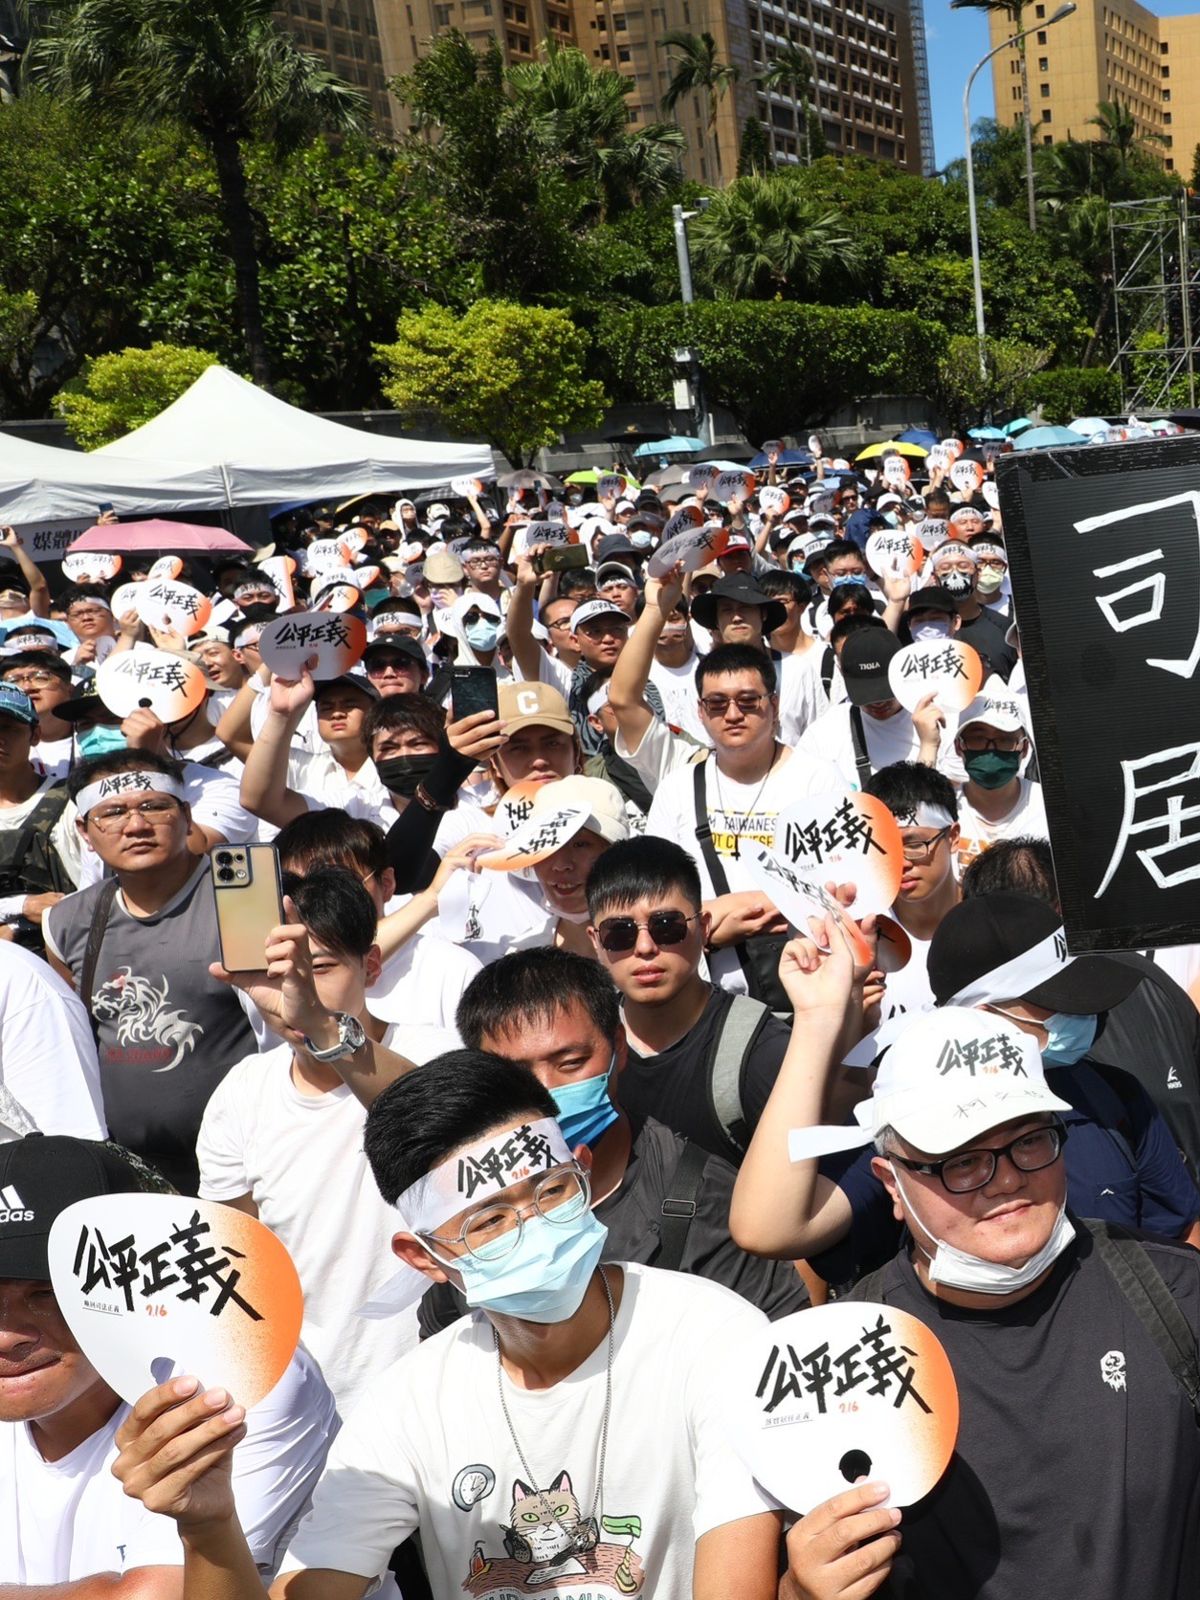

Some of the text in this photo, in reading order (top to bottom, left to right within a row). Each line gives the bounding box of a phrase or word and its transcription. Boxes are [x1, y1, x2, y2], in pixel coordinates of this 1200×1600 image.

[875, 536, 915, 560] 公平正義
[150, 583, 202, 621] 公平正義
[274, 616, 352, 650] 公平正義
[114, 658, 191, 698] 公平正義
[900, 643, 970, 681] 公平正義
[516, 691, 540, 715] C
[100, 770, 154, 797] 公平正義
[785, 797, 887, 864] 公平正義
[936, 1031, 1029, 1079] 公平正義
[457, 1125, 561, 1199] 公平正義
[73, 1209, 266, 1322] 公平正義
[755, 1313, 934, 1415] 公平正義
